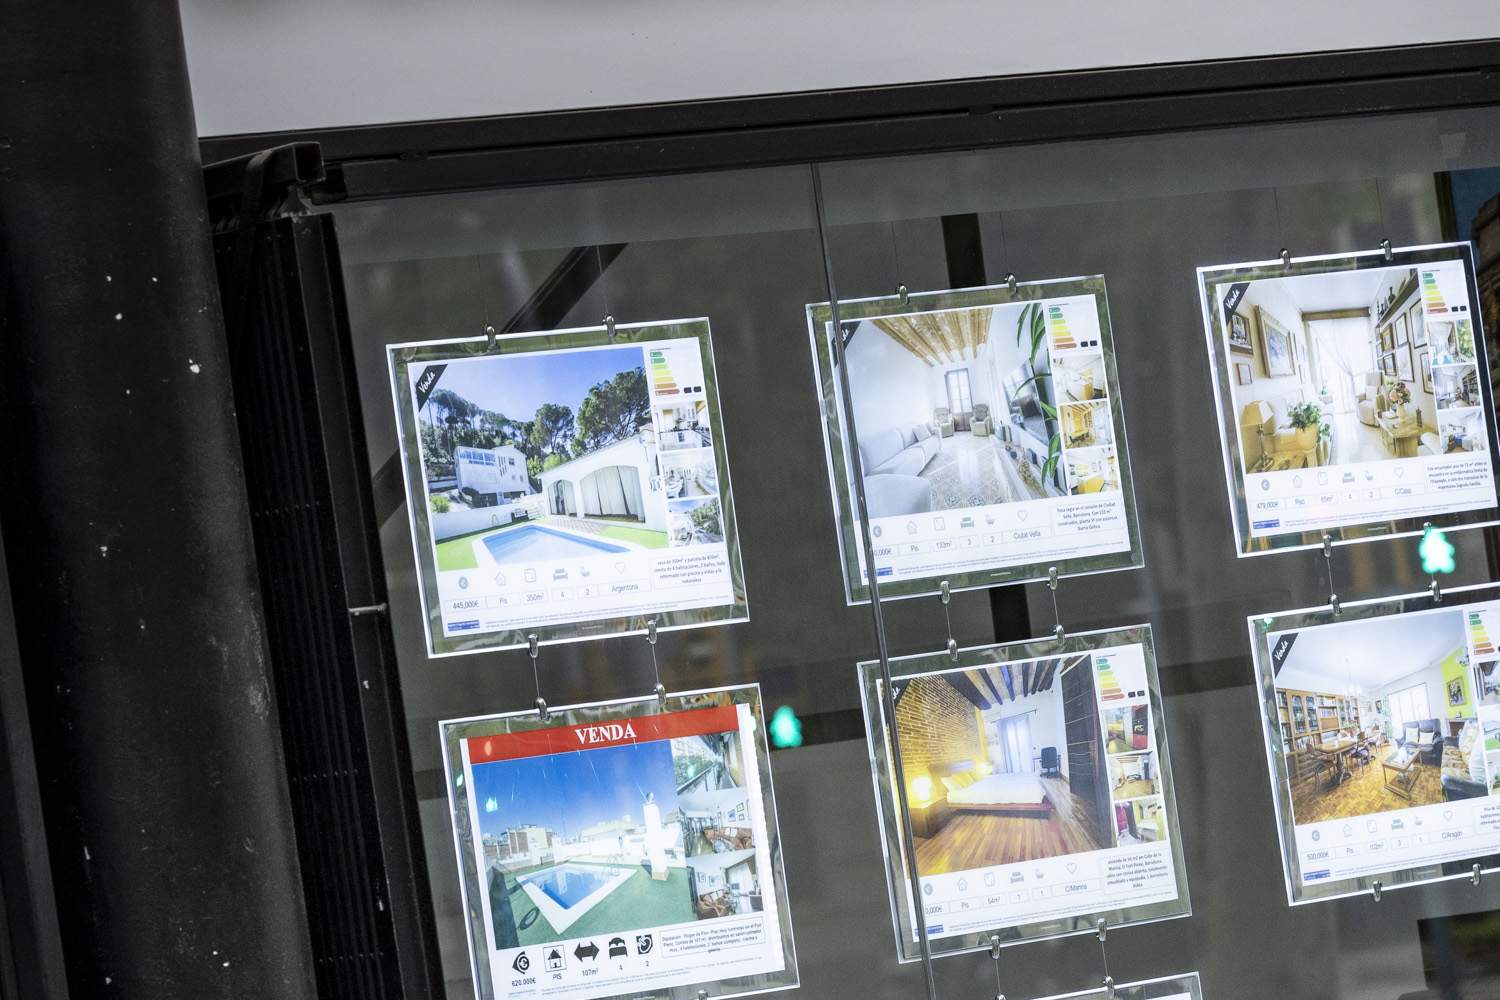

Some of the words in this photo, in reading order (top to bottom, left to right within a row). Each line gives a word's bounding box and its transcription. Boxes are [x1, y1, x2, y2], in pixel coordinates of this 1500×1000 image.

[418, 371, 436, 393] Venda
[574, 721, 637, 745] VENDA
[581, 968, 599, 977] 107m²
